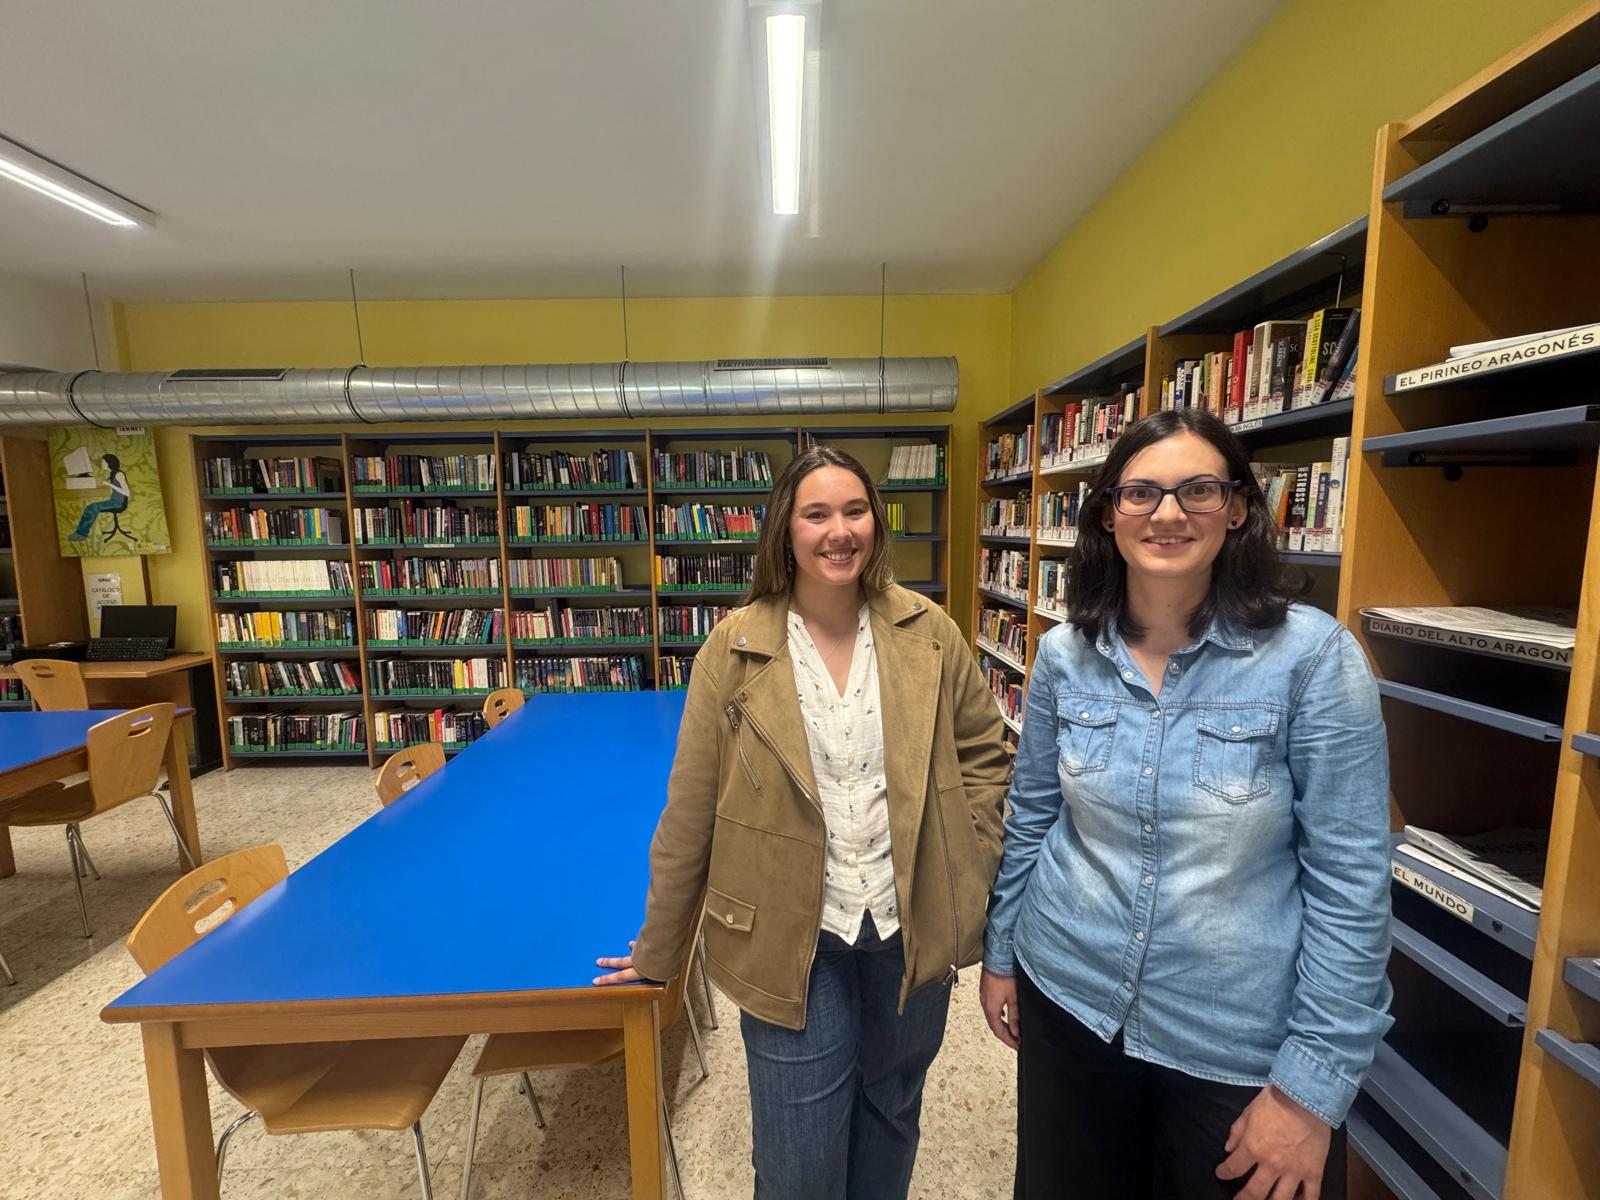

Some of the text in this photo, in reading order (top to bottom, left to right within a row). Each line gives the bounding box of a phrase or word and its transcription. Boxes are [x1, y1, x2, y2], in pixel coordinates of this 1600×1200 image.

[1400, 332, 1595, 387] EL PIRINEO ARAGONÉS
[1294, 472, 1308, 503] STROSS
[1372, 621, 1569, 663] DIARIO DEL ALTO ARAGON
[1393, 866, 1467, 915] EL MUNDO
